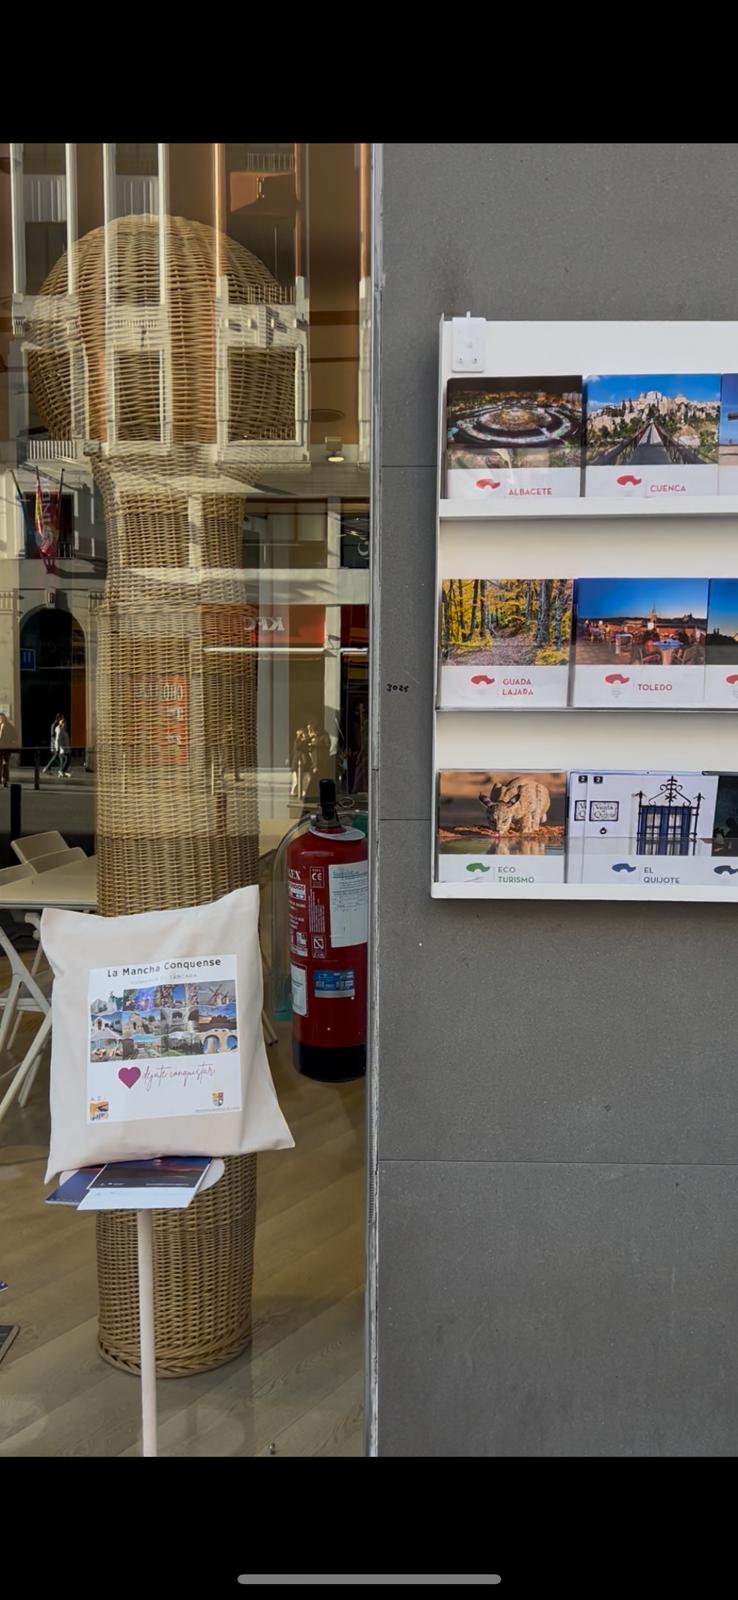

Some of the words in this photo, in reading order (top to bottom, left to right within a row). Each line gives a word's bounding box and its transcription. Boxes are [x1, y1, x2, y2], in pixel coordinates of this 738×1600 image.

[508, 487, 553, 496] ALBACETE
[650, 484, 686, 493] CUENCA
[502, 678, 532, 686] GUADA
[637, 683, 673, 692] TOLEDO
[502, 688, 534, 696] LAJARA
[497, 866, 516, 874] ECO
[643, 866, 654, 874] EL
[497, 876, 535, 884] TURISMO
[643, 876, 680, 885] QUIJOTE
[107, 969, 118, 978] La
[122, 965, 161, 976] Mancha
[164, 958, 222, 970] Conquense
